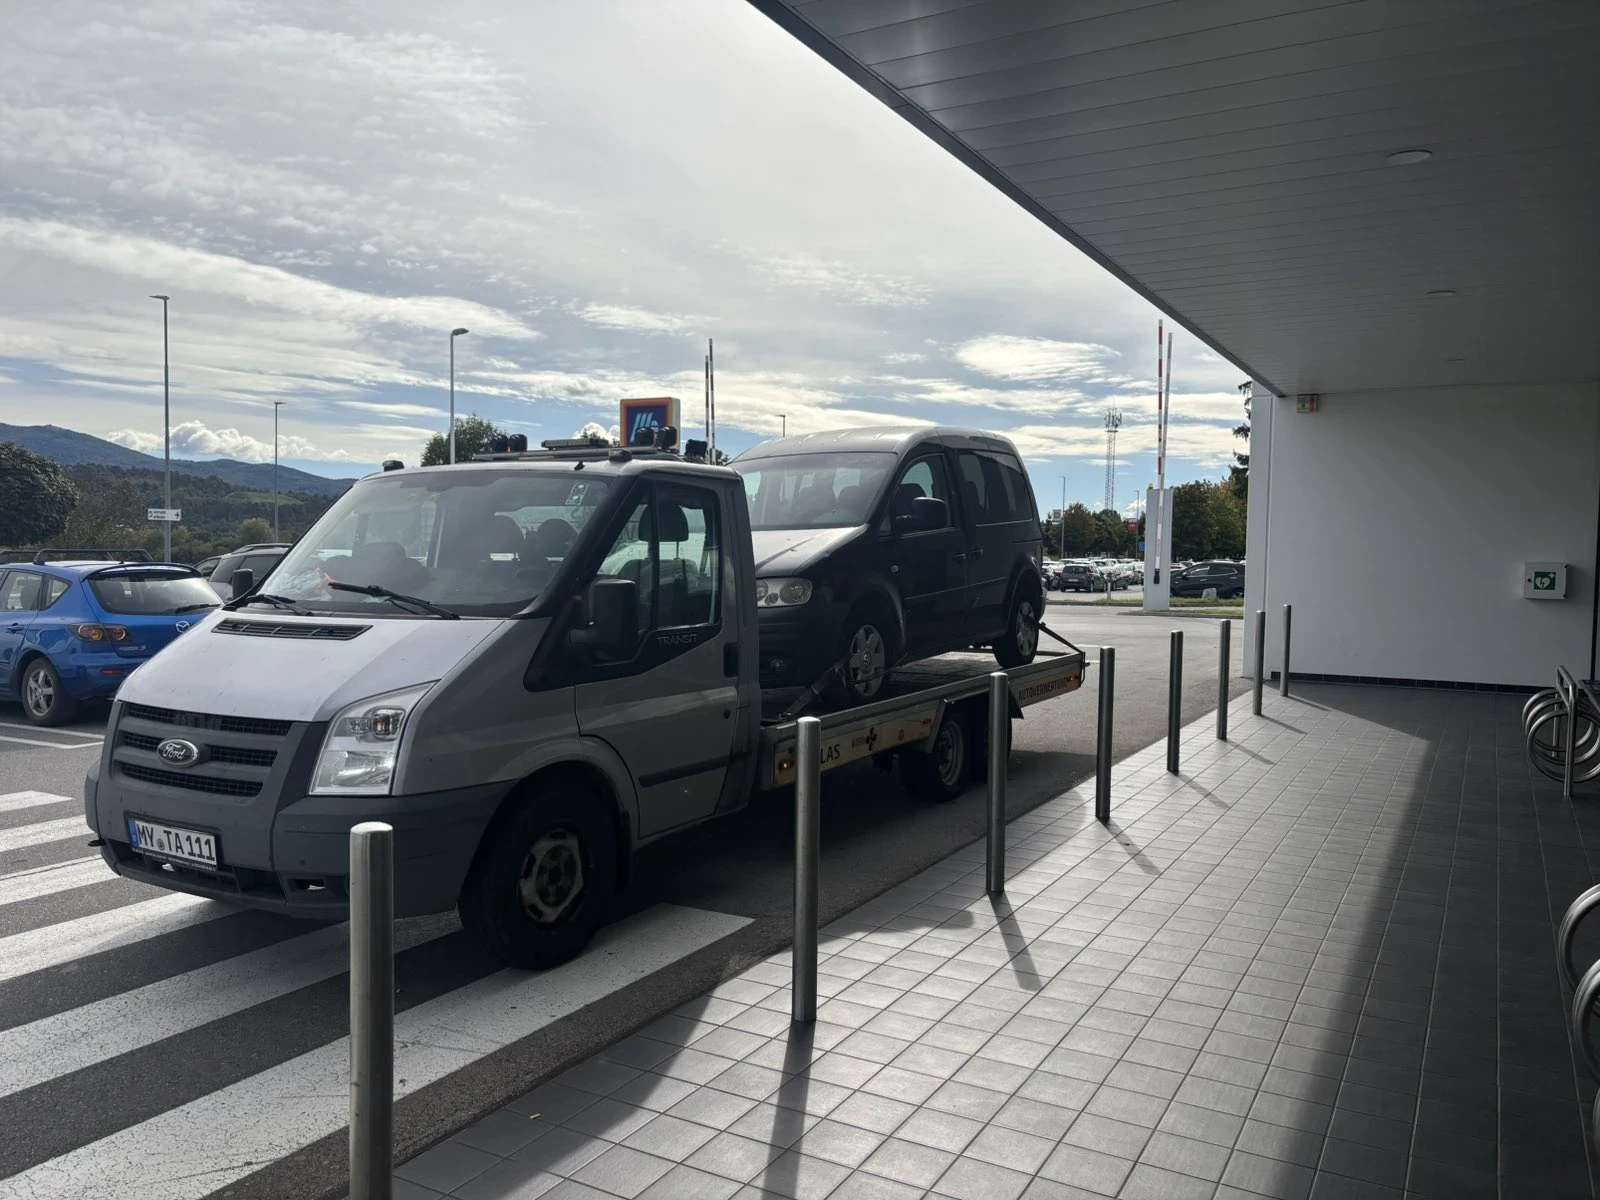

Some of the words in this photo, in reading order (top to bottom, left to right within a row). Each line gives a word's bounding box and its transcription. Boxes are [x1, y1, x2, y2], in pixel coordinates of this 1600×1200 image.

[655, 632, 698, 648] TRANSIT
[162, 742, 187, 760] Ford
[136, 823, 154, 848] MY
